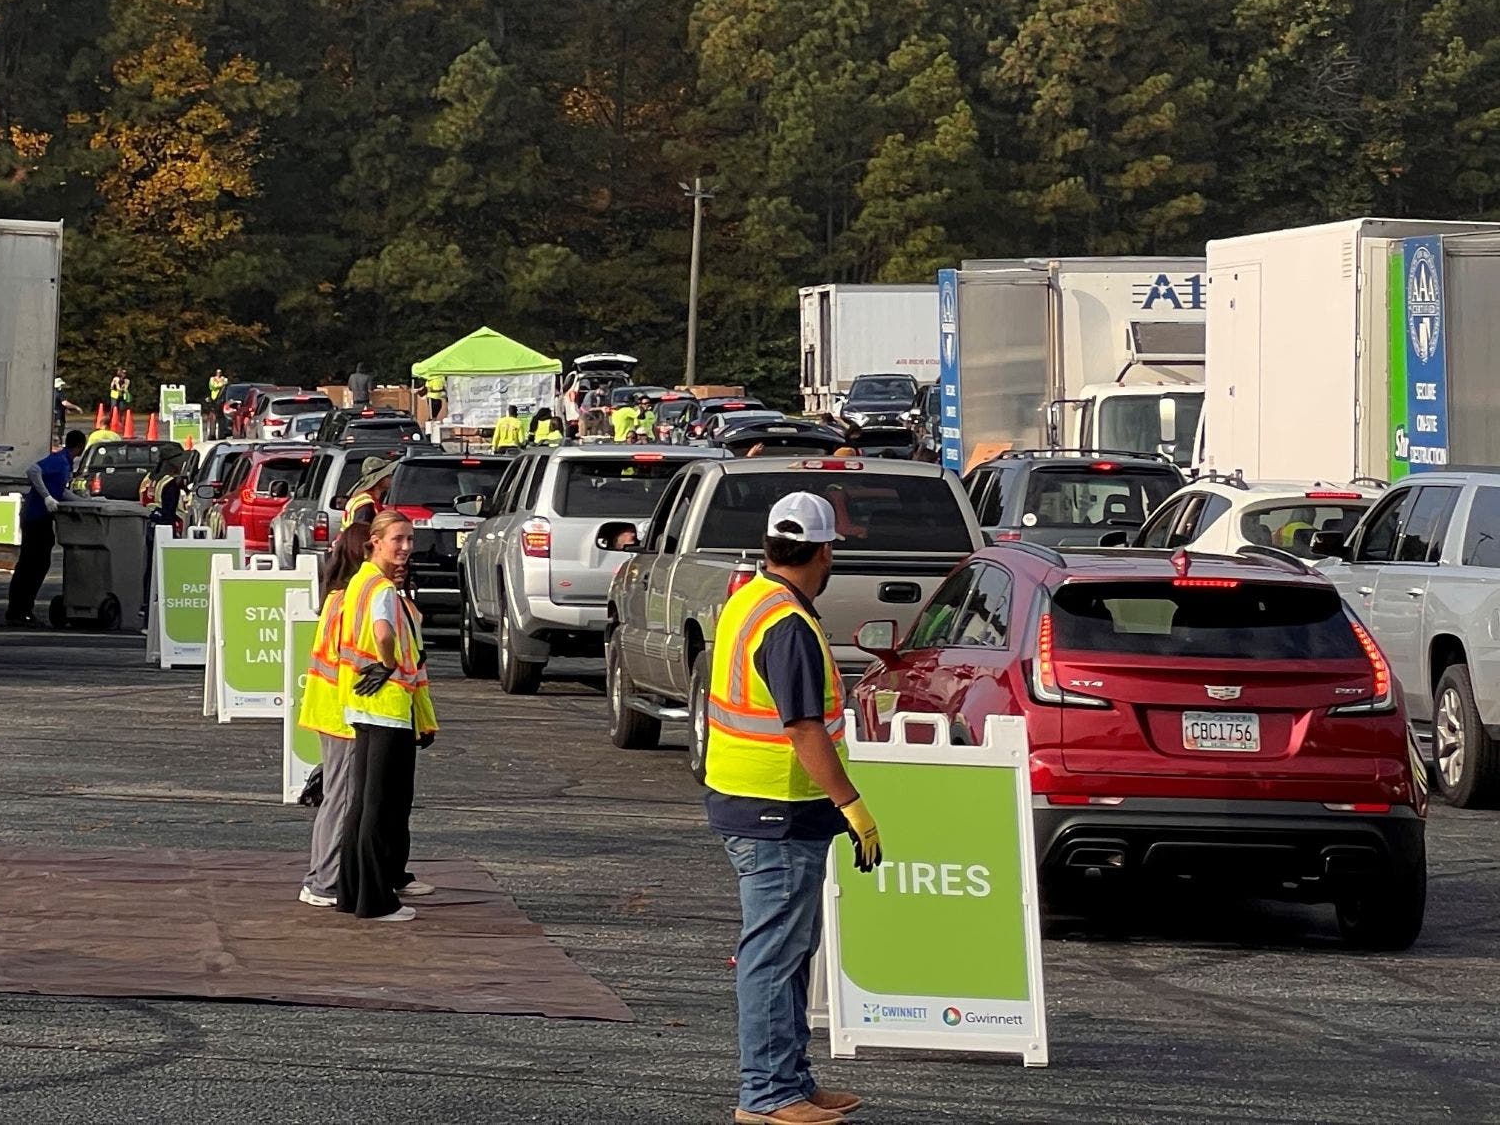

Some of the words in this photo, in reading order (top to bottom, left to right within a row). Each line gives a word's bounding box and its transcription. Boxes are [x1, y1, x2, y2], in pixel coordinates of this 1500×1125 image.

[1412, 263, 1436, 302] AAA
[1140, 274, 1206, 309] A1
[182, 583, 208, 594] PAP
[166, 598, 209, 609] SHRED
[259, 628, 278, 642] IN
[245, 648, 282, 663] LAN
[1191, 722, 1252, 742] CBC1756
[875, 861, 992, 897] TIRES
[881, 1005, 928, 1019] GWINNETT
[965, 1011, 1024, 1026] Gwinnett
